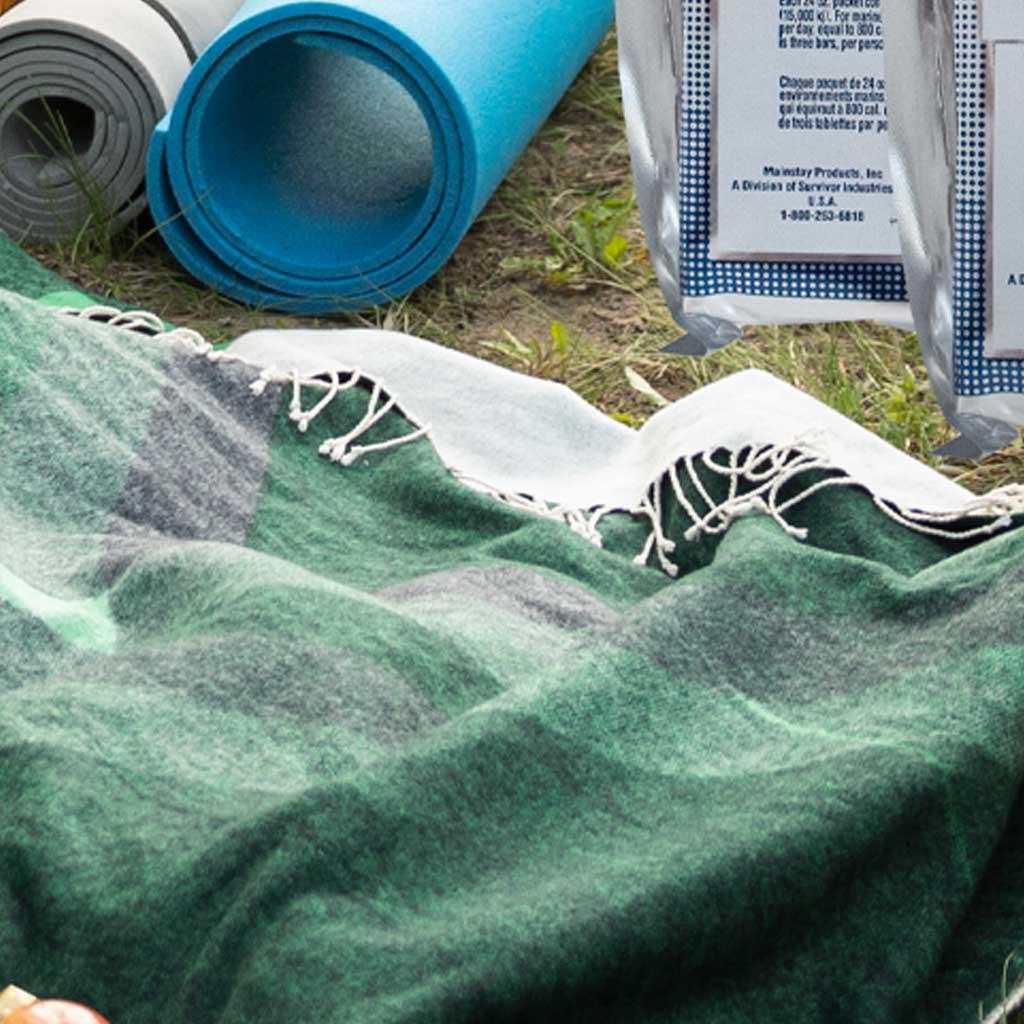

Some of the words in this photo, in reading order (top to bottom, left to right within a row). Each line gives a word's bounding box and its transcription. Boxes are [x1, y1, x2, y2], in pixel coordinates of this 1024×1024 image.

[762, 166, 812, 178] Mainstay
[731, 179, 740, 191] A
[741, 180, 783, 192] Division
[785, 180, 797, 192] of
[797, 181, 841, 193] Survivor
[1007, 275, 1017, 286] A
